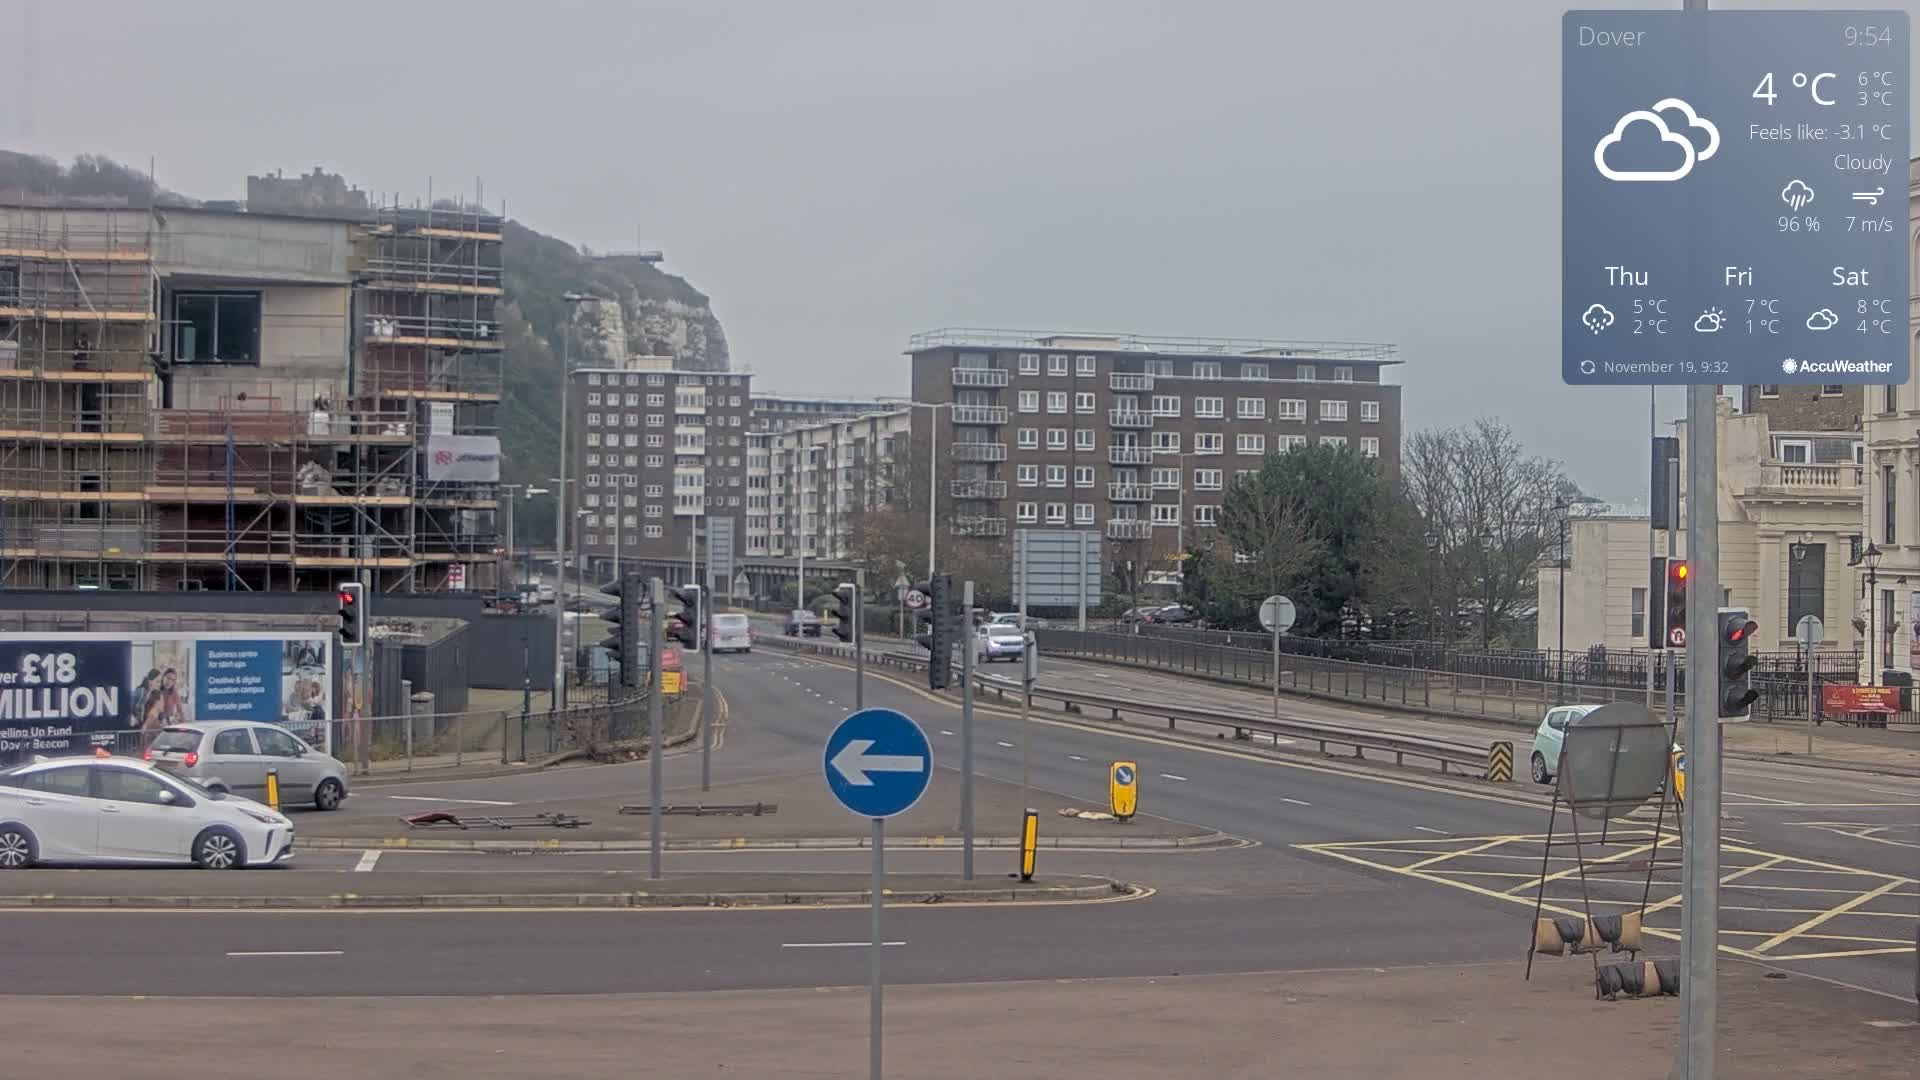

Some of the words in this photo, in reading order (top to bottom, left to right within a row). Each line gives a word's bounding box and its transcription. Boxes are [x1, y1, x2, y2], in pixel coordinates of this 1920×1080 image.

[908, 594, 923, 602] 40
[22, 653, 77, 683] £18
[48, 726, 72, 737] Fund
[33, 739, 69, 750] Beacon
